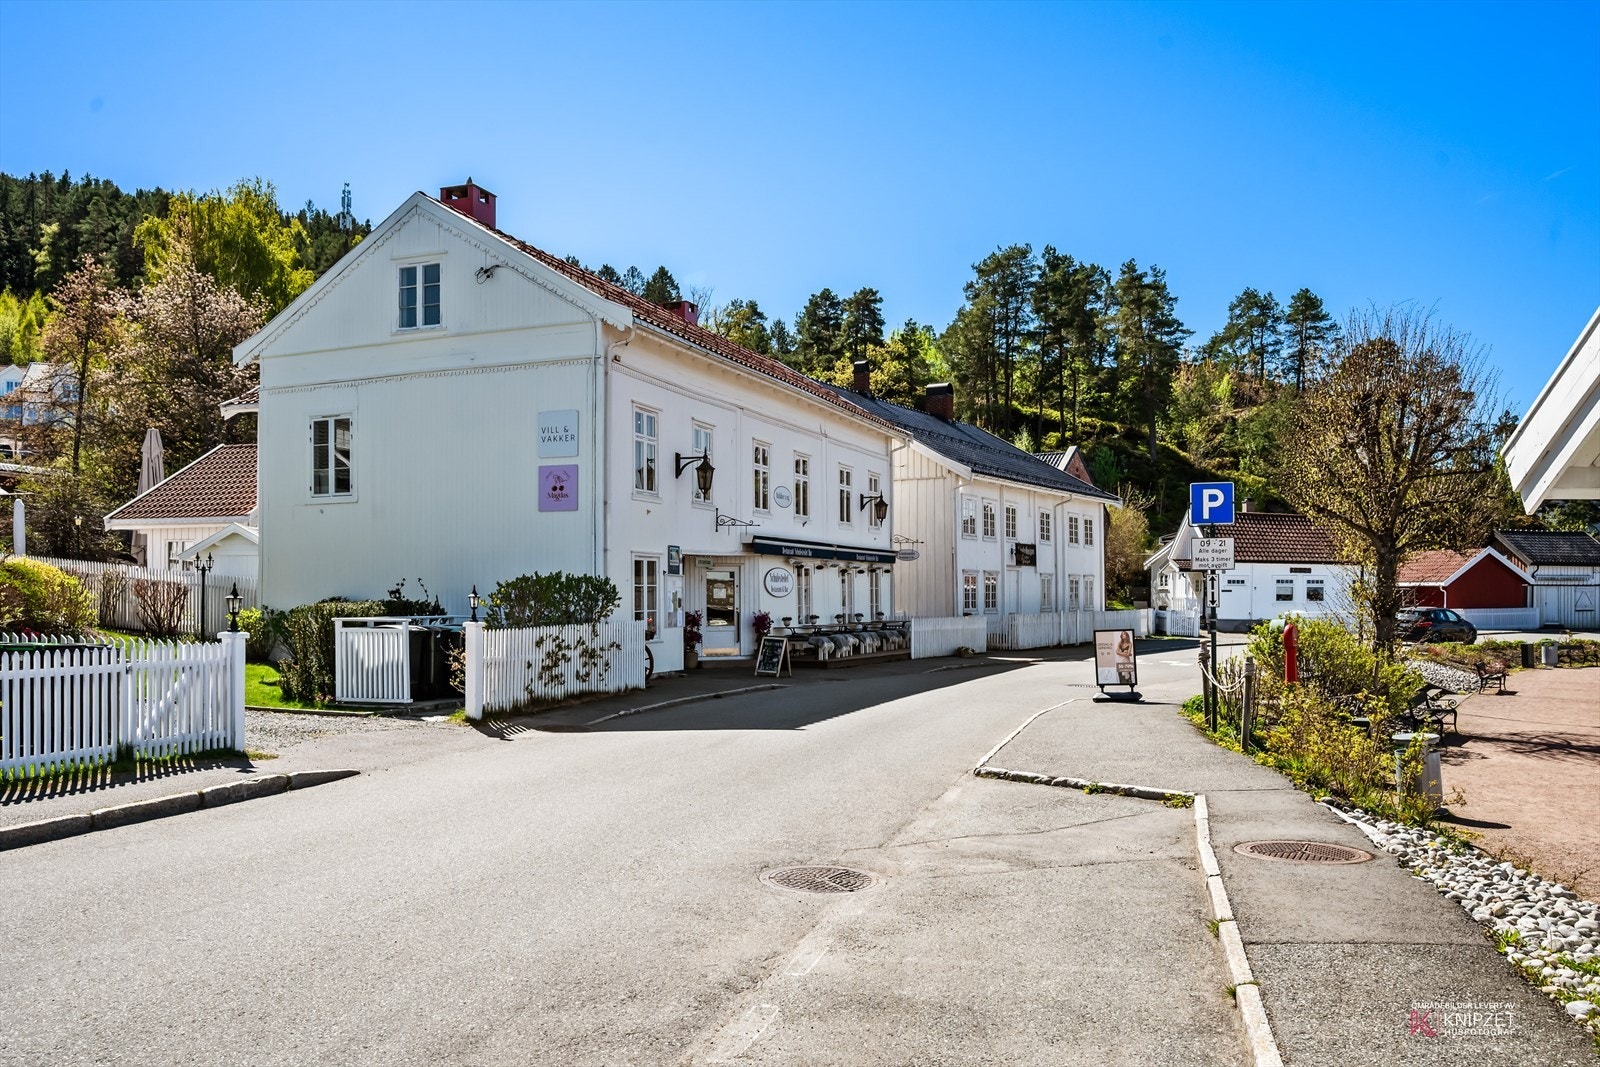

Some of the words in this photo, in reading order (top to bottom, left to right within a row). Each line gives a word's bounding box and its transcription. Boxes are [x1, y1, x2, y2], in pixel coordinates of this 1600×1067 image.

[541, 426, 559, 434] VILL
[541, 434, 576, 443] VAKKER
[1203, 489, 1224, 519] P
[1200, 540, 1211, 548] 09
